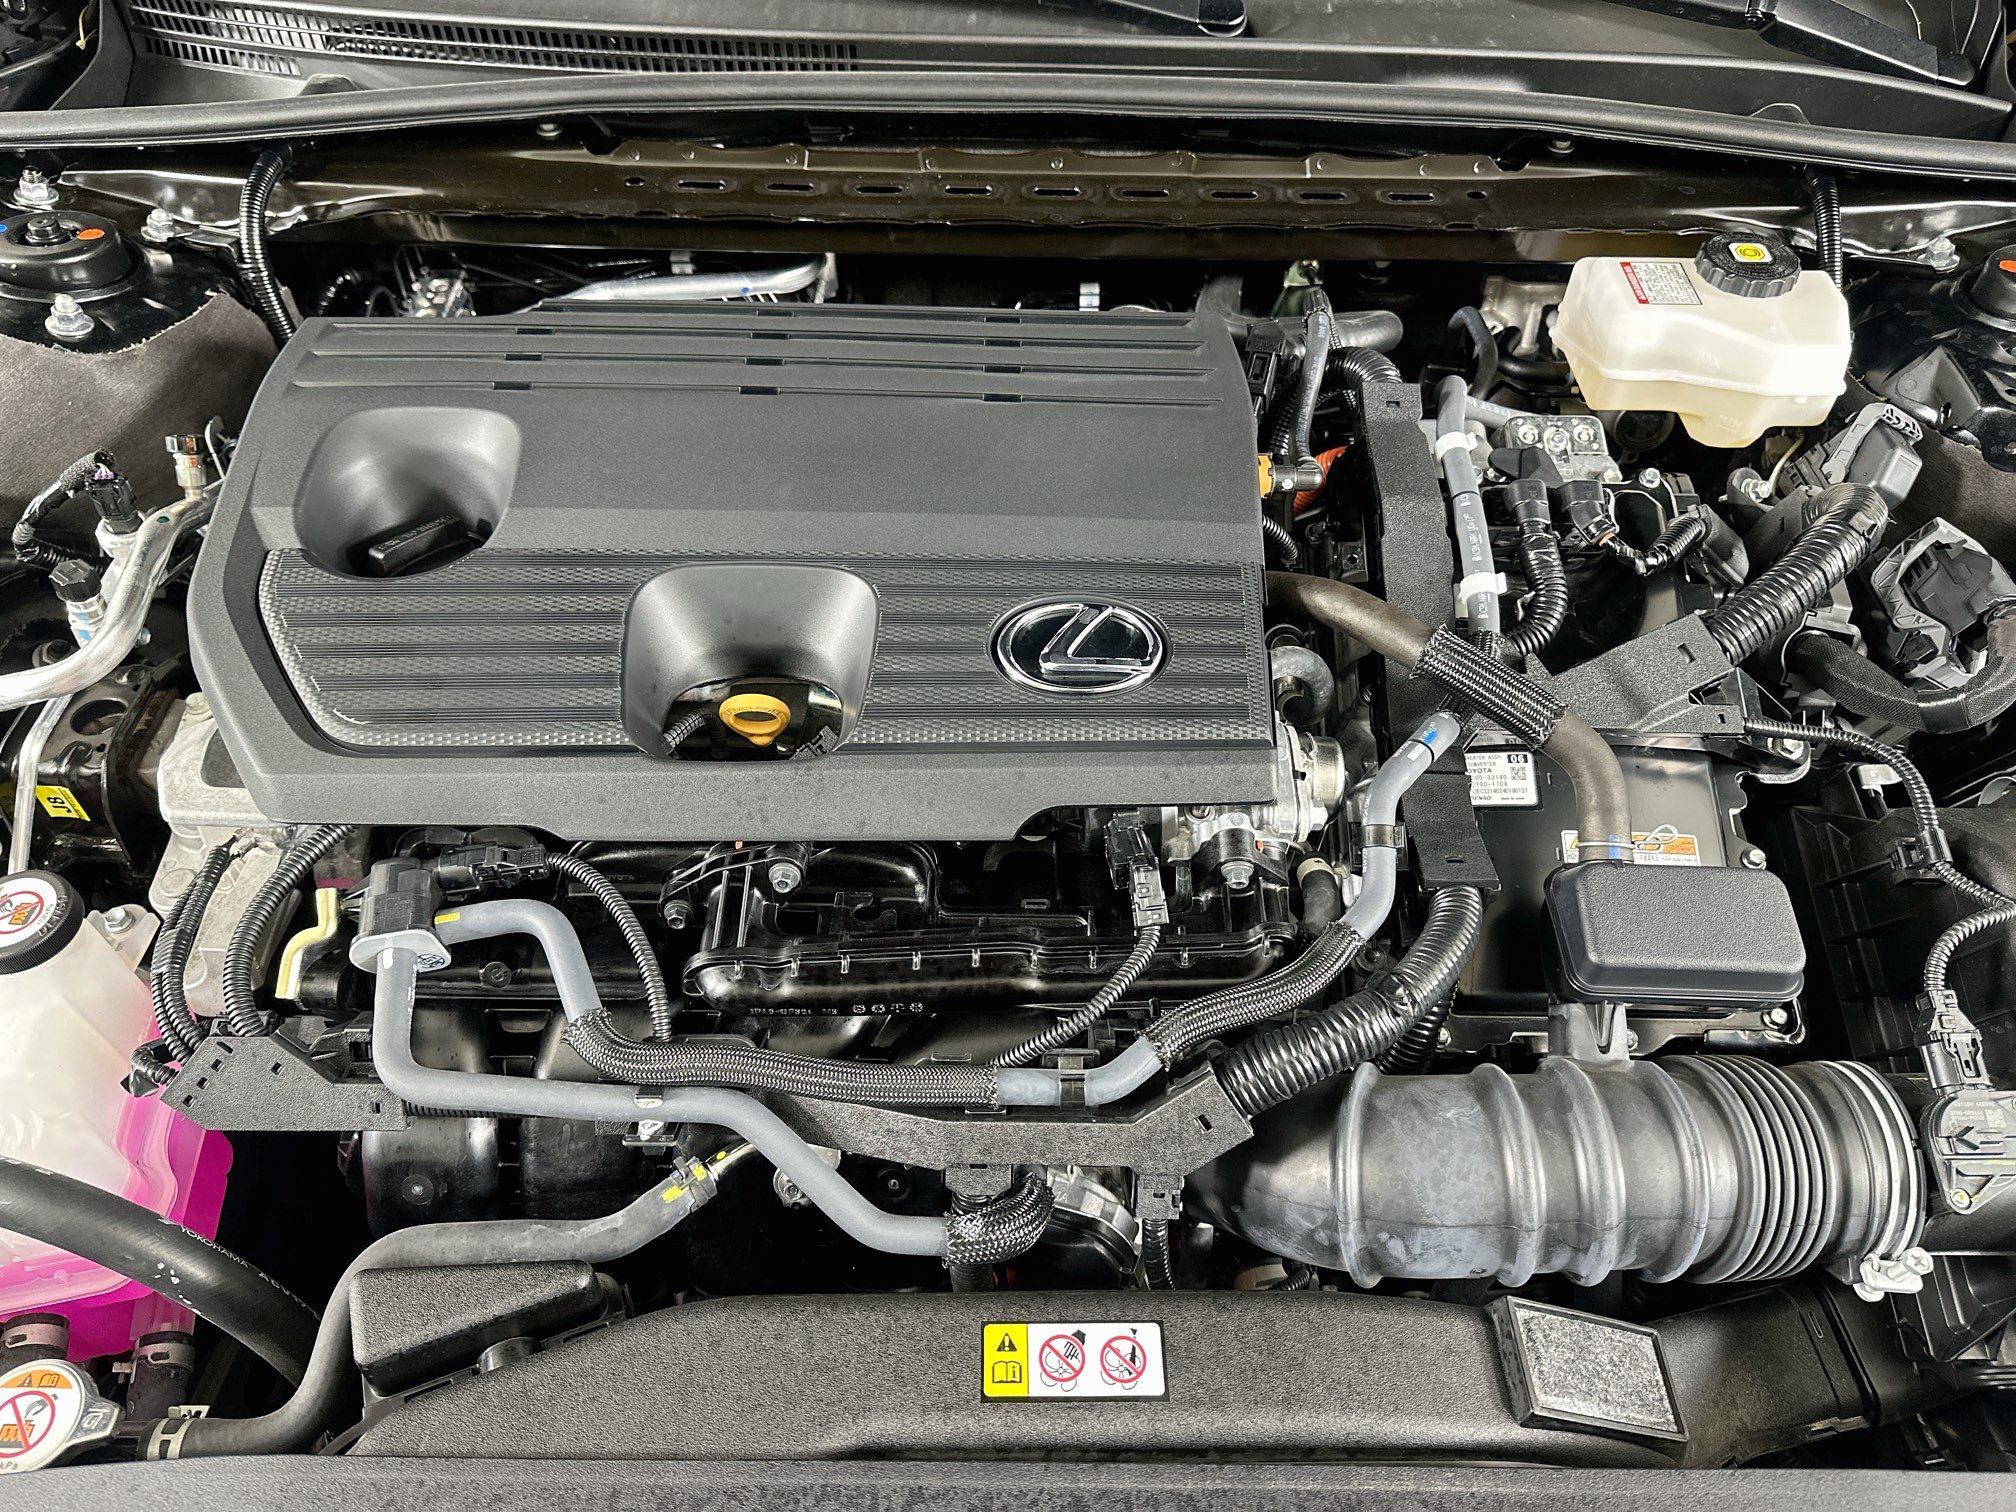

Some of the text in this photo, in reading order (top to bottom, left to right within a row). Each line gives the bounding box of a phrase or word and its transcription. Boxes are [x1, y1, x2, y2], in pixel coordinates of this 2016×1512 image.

[1510, 754, 1525, 763] 06
[46, 796, 72, 813] J8
[38, 895, 68, 937] DENSO
[180, 1225, 249, 1269] YOKOHAMA
